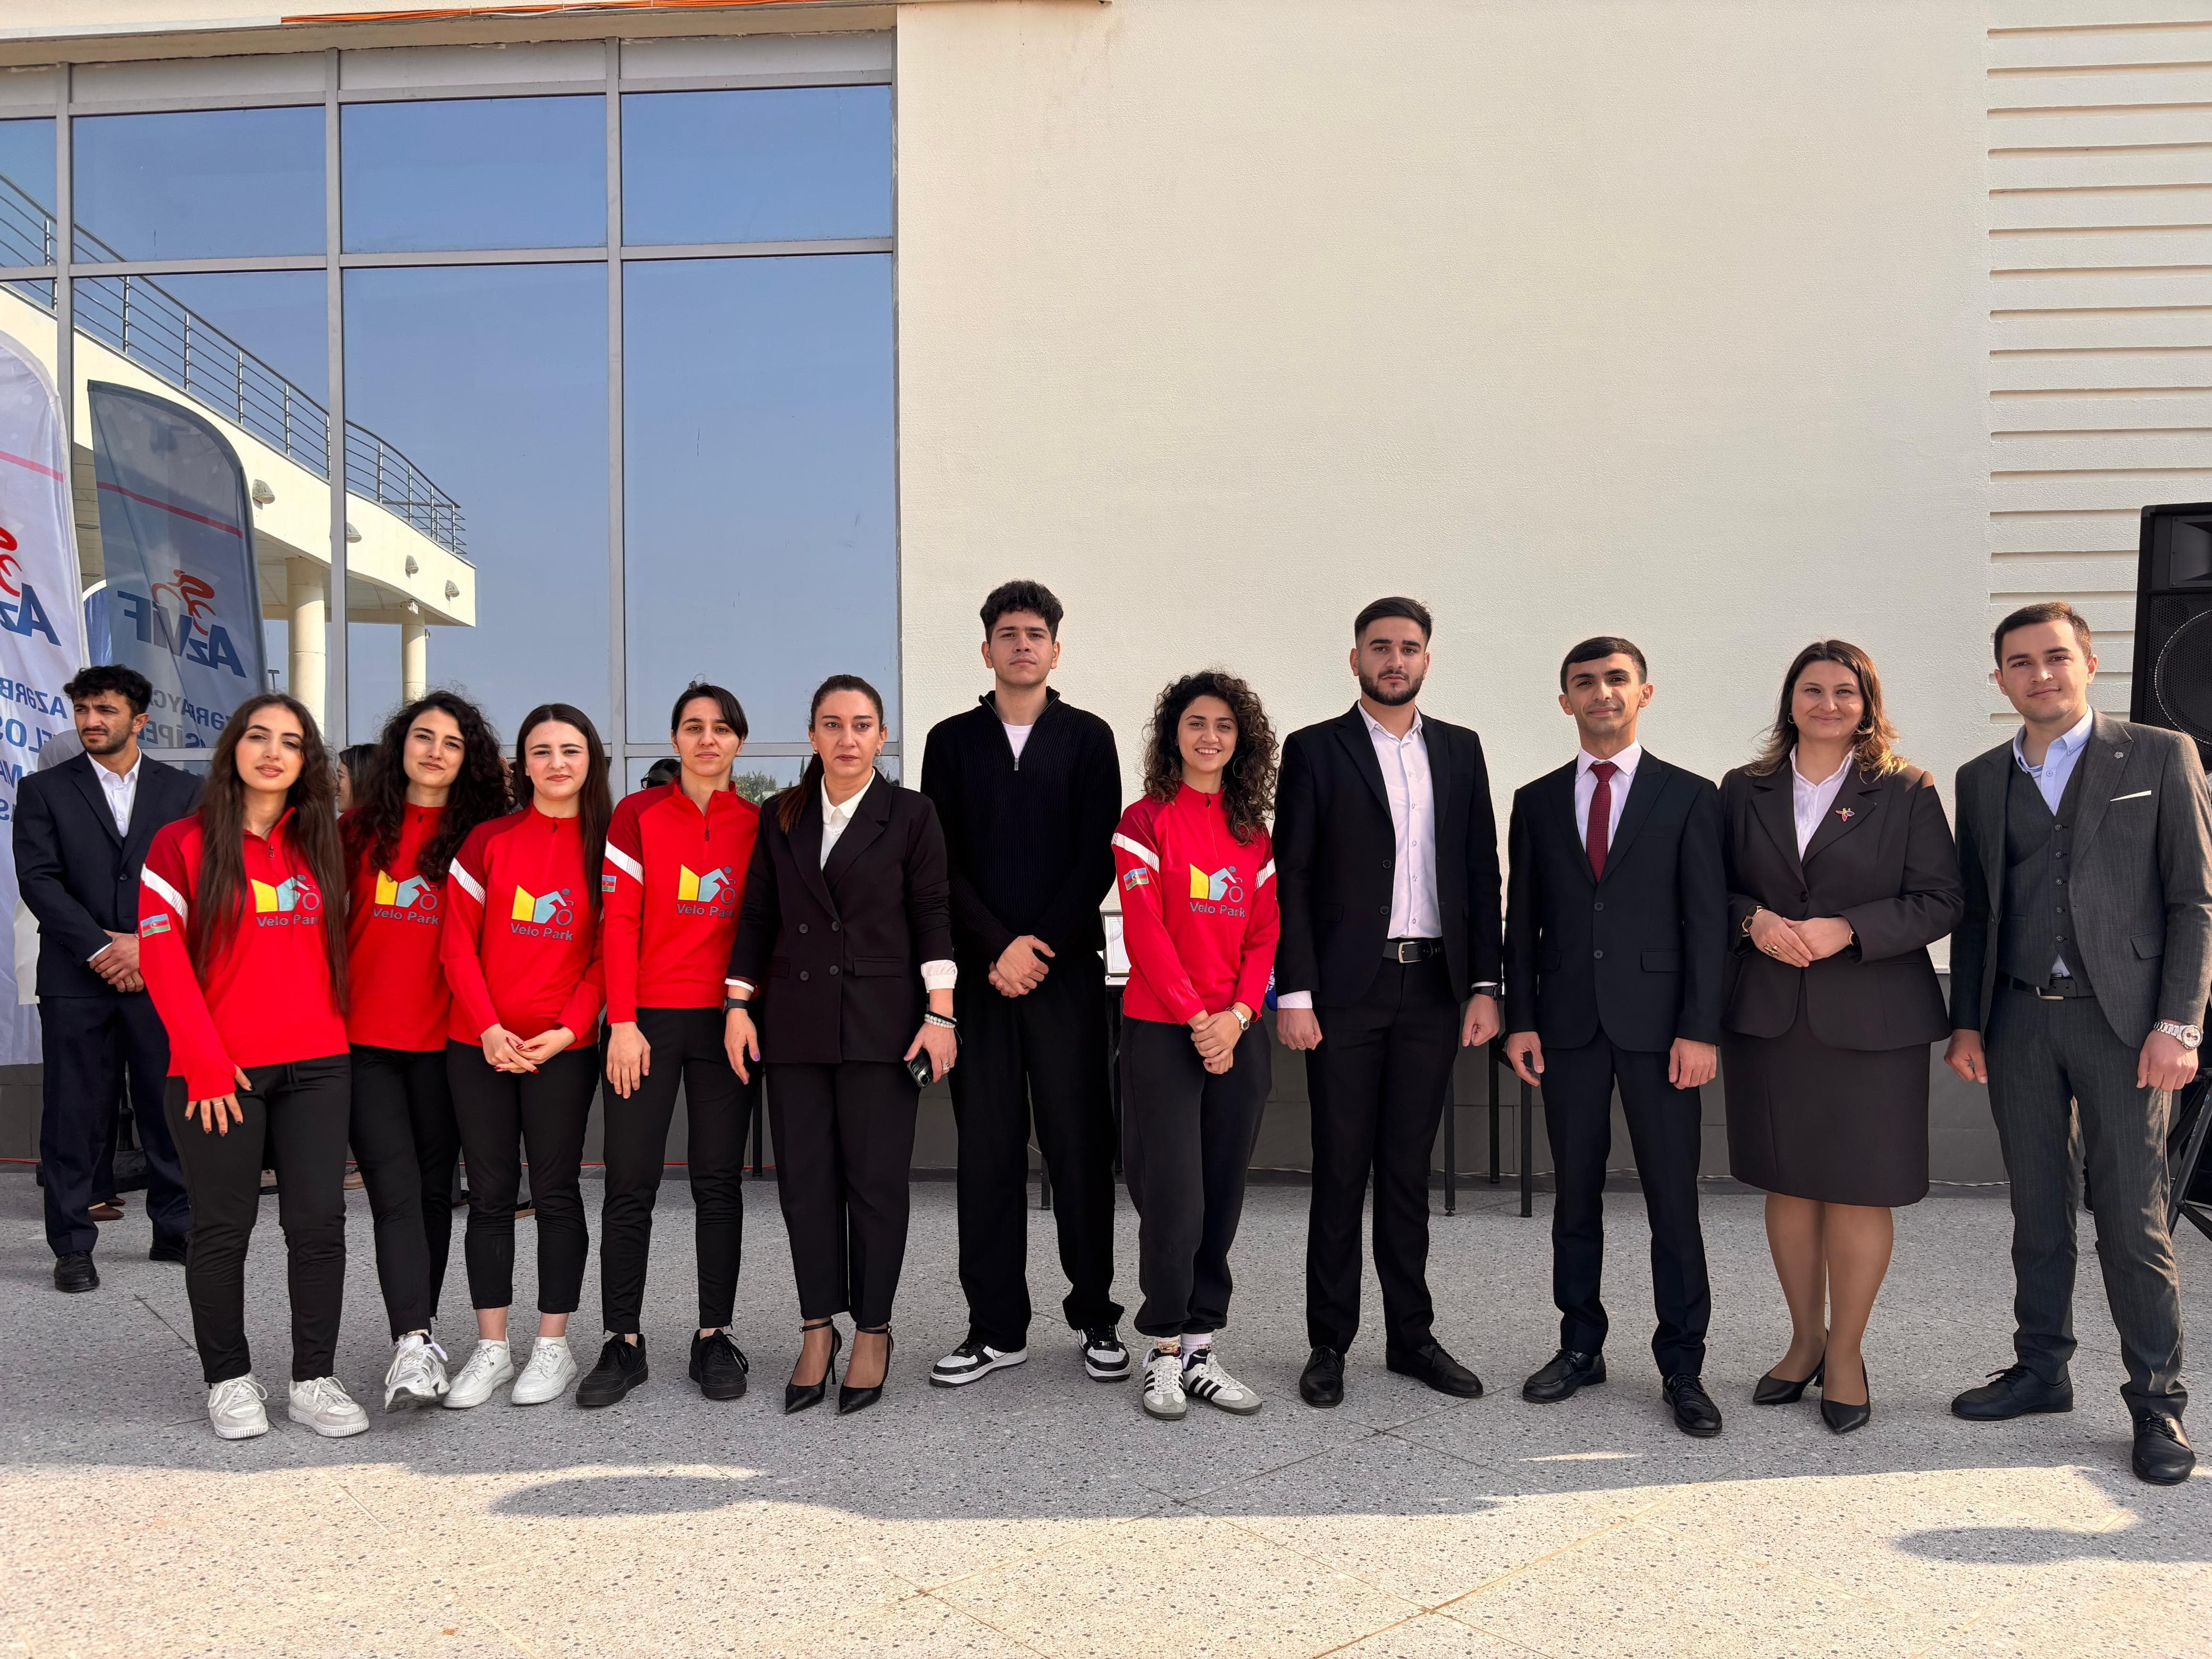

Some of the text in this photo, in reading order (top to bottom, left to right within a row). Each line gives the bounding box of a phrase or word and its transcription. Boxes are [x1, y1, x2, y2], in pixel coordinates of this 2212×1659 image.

[373, 908, 439, 925] Velo Park
[677, 903, 705, 915] Velo
[1189, 901, 1245, 917] Velo Park
[256, 916, 289, 927] Velo
[510, 923, 573, 941] Velo Park
